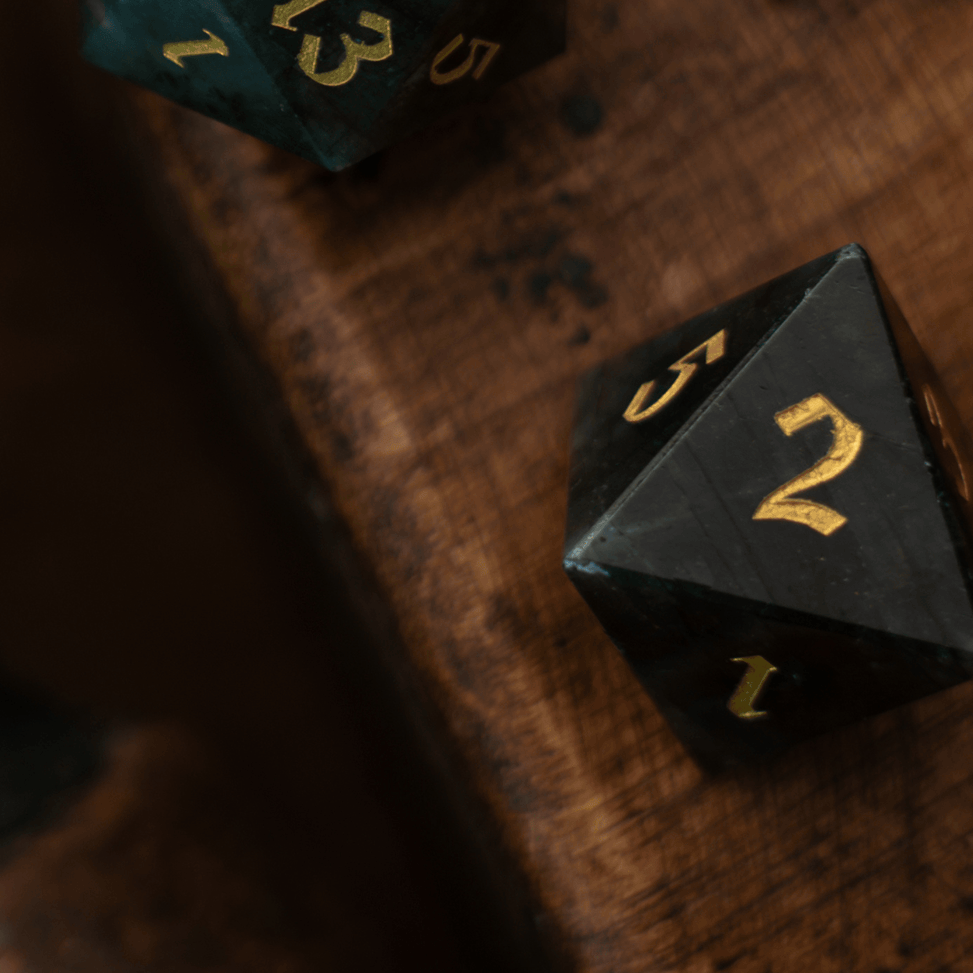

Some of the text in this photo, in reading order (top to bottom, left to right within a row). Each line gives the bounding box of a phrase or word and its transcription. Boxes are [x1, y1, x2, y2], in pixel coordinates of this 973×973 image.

[162, 28, 230, 68] 1
[429, 33, 501, 85] 5
[622, 329, 726, 423] 5
[752, 392, 865, 537] 2
[726, 655, 779, 719] 1
